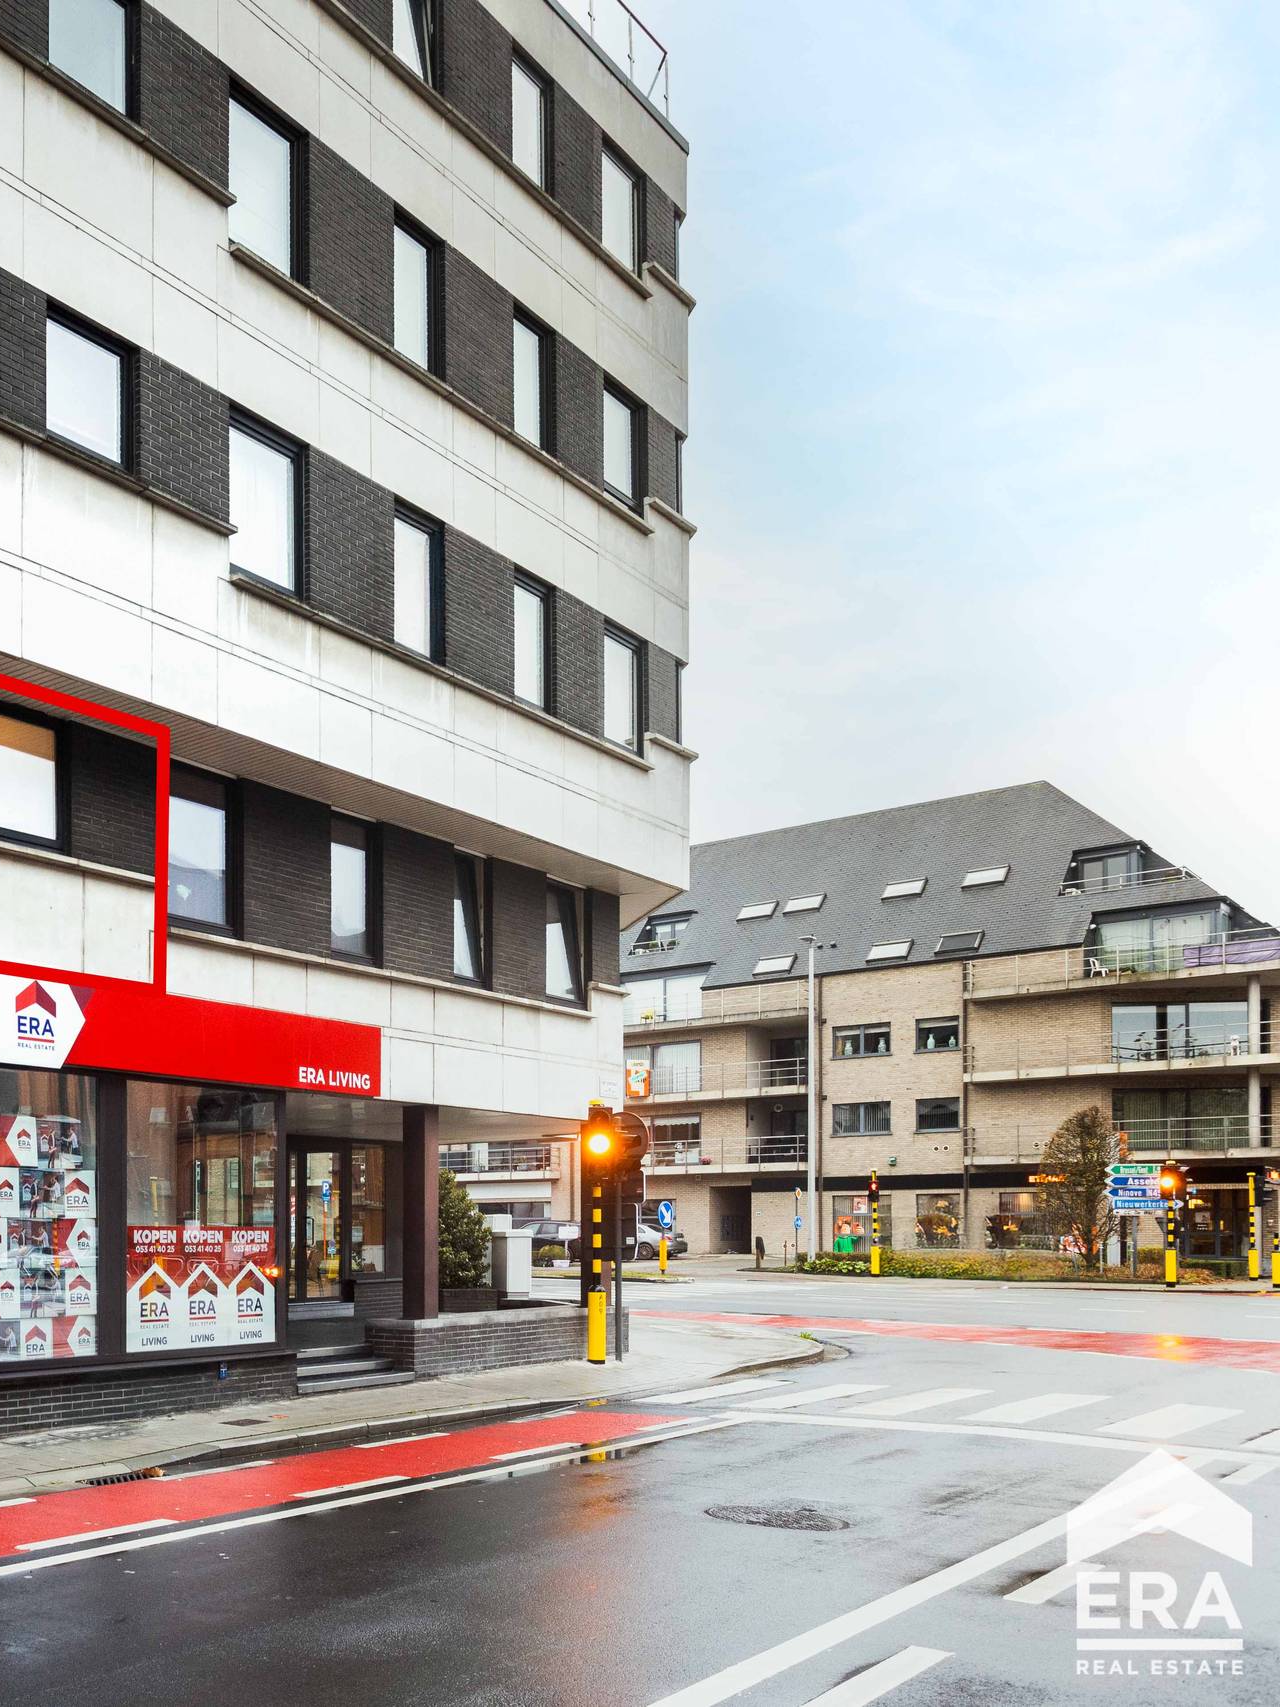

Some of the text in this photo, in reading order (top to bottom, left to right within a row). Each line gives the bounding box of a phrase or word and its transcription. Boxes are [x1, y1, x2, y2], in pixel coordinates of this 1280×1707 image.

[17, 1015, 54, 1037] ERA
[298, 1066, 371, 1090] ERA LIVING
[1118, 1189, 1142, 1197] Ninove
[66, 1195, 89, 1205] ERA
[1116, 1200, 1169, 1208] Nieuwerkerke
[133, 1230, 176, 1243] KOPEN
[183, 1230, 223, 1243] KOPEN
[231, 1230, 269, 1243] KOPEN
[140, 1302, 169, 1317] ERA
[189, 1300, 216, 1315] ERA
[237, 1298, 263, 1312] ERA
[190, 1334, 215, 1343] LIVING
[239, 1330, 262, 1339] LIVING
[26, 1343, 45, 1353] ERA
[141, 1337, 167, 1346] LIVING
